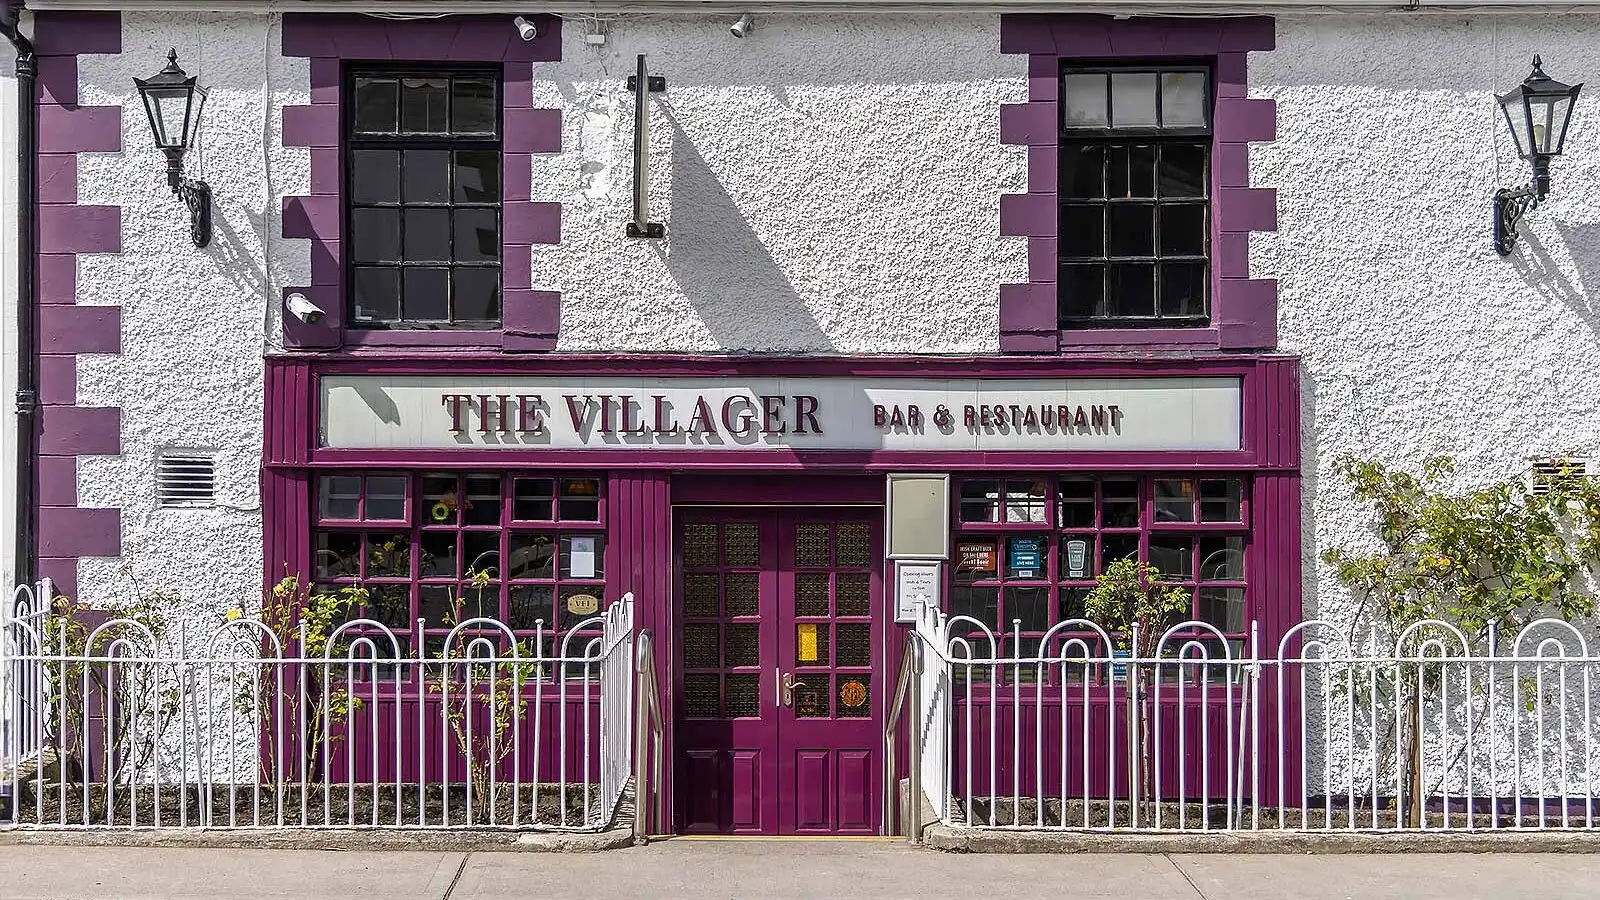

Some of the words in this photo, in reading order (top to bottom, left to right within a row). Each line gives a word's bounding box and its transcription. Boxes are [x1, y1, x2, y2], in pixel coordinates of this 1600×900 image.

[441, 393, 545, 433] THE
[561, 393, 824, 435] VILLAGER
[873, 404, 920, 427] BAR
[933, 403, 949, 427] &
[963, 404, 1120, 427] RESTAURANT
